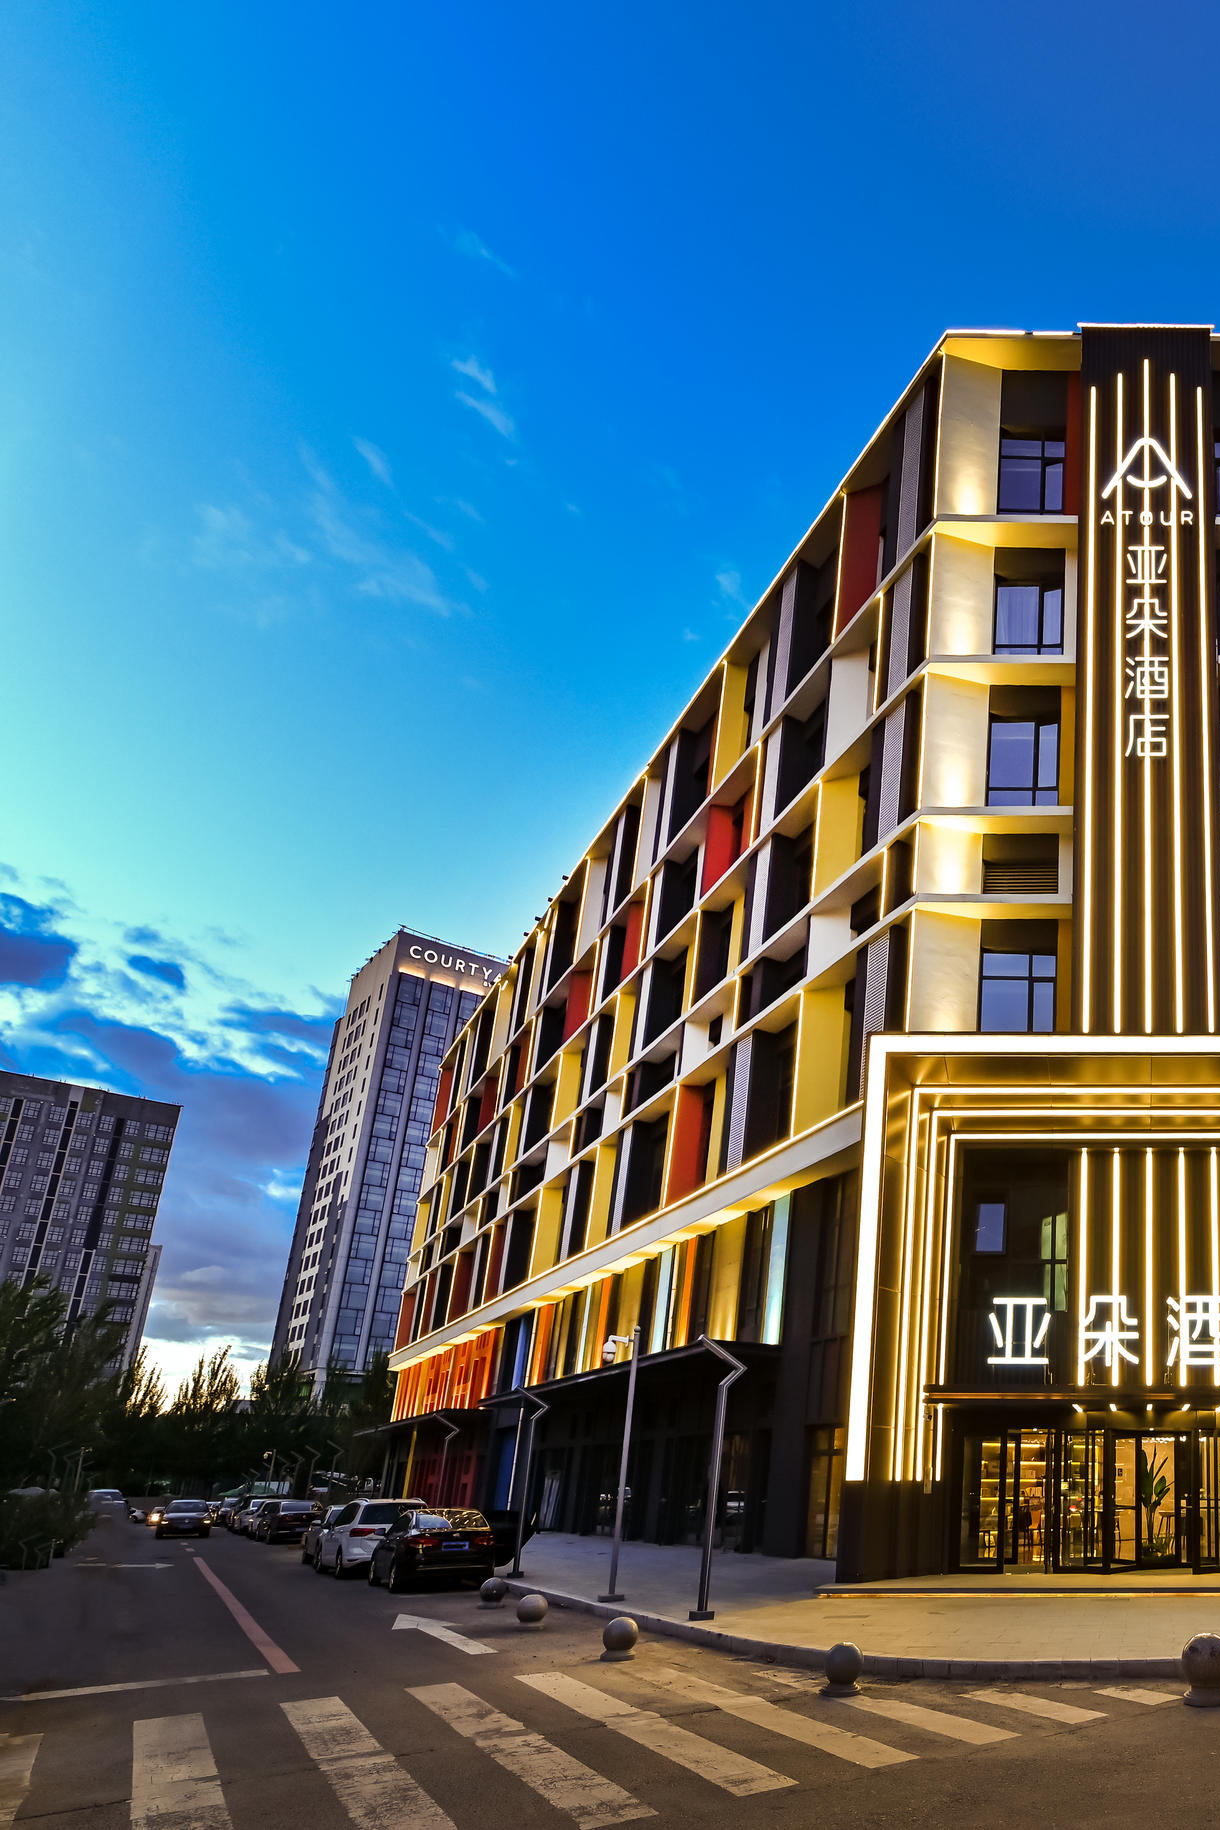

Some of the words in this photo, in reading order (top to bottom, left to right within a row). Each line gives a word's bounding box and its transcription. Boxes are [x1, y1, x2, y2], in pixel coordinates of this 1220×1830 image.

[1100, 510, 1194, 526] ATOUR
[1125, 545, 1169, 758] 亚朵酒店
